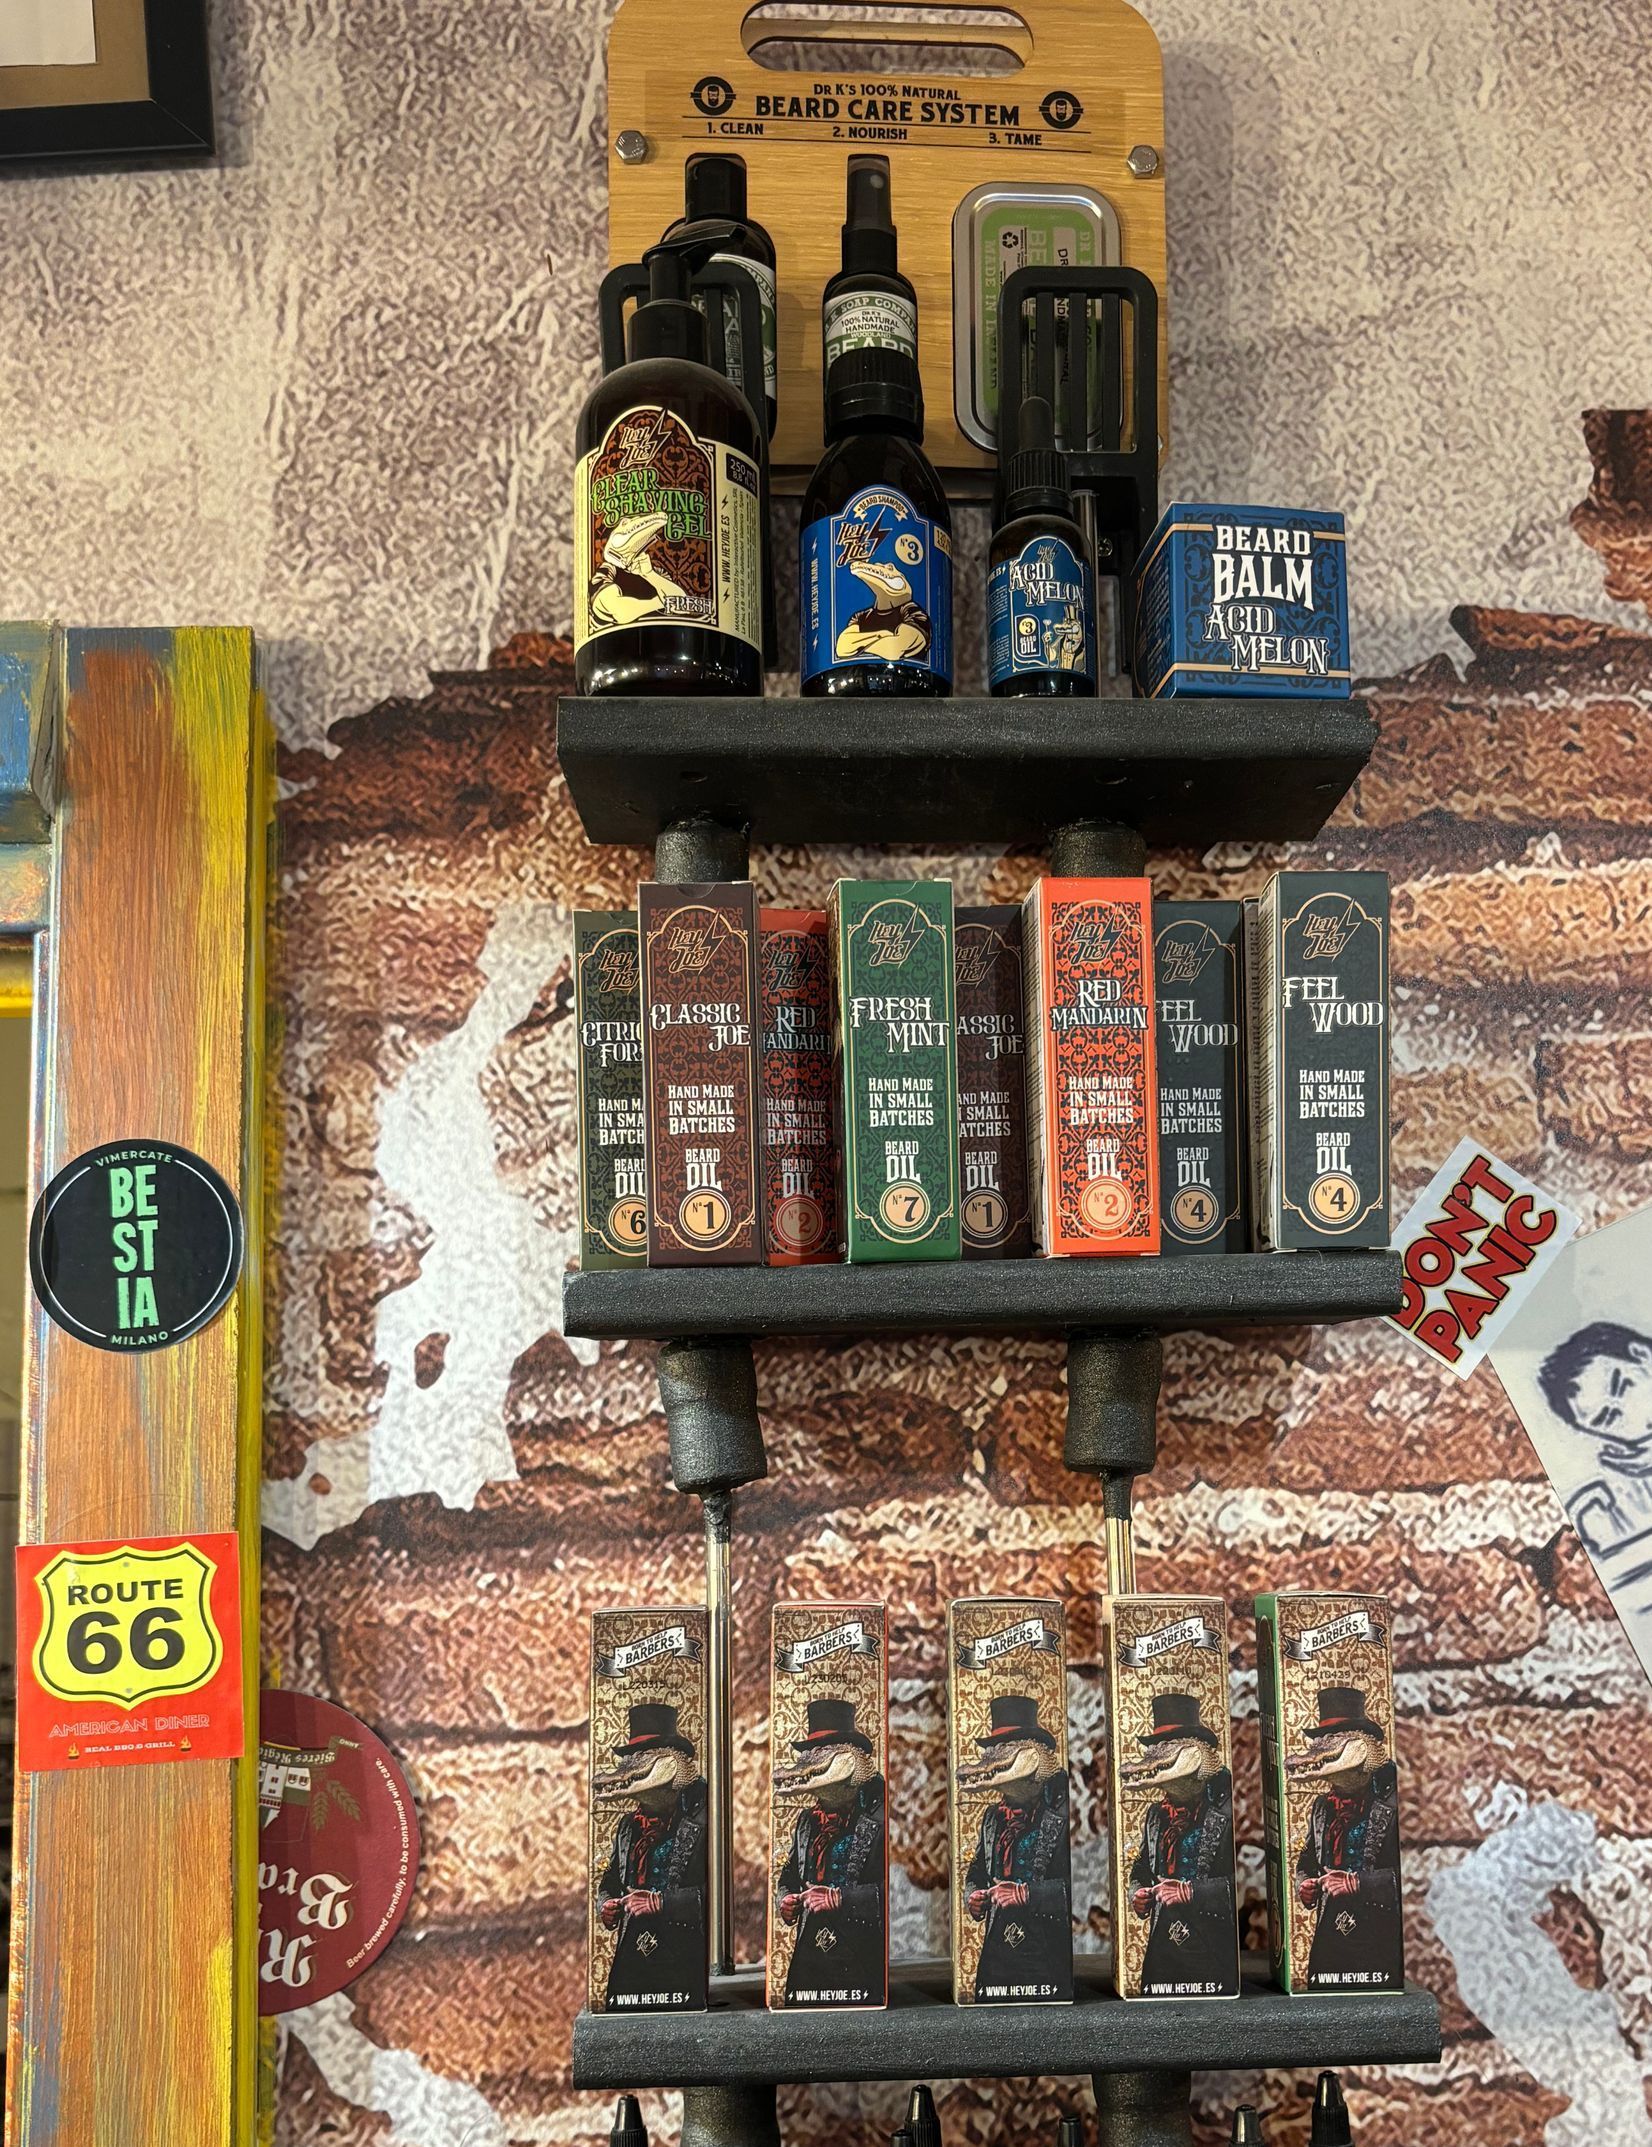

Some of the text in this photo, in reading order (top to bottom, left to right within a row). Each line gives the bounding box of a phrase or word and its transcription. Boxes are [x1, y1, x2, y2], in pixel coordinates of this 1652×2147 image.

[860, 84, 898, 98] 100%
[902, 85, 961, 101] NATURAL
[755, 96, 1020, 126] BEARD CARE SYSTEM
[707, 122, 764, 135] 1. CLEAN
[832, 126, 908, 140] 2. NOURISH
[988, 132, 1042, 146] 3. TAME
[840, 297, 870, 312] SOAP
[985, 293, 997, 314] IN
[841, 316, 900, 328] 100% NATURAL
[845, 324, 896, 334] HANDMADE
[730, 458, 746, 475] 250
[592, 468, 659, 514] CLEAR
[605, 489, 706, 530] SHAVING
[858, 496, 905, 512] BEARD SHAMPOO
[665, 512, 712, 542] GEL
[720, 514, 732, 584] WWW.HEYJOE.ES
[1216, 524, 1311, 556] BEARD
[907, 541, 920, 561] 3
[1010, 562, 1054, 592] ACID
[1212, 552, 1315, 613] BALM
[1026, 580, 1084, 610] MELON
[664, 595, 714, 616] FRESH
[1204, 603, 1276, 641] ACID
[1020, 636, 1036, 646] BEARD
[1020, 642, 1037, 655] OIL
[1231, 634, 1330, 676] MELON
[1076, 978, 1122, 1007] RED
[1282, 976, 1345, 1008] FEEL
[650, 1002, 740, 1031] CLASSIC
[776, 1006, 816, 1034] RED
[850, 996, 932, 1030] FRESH
[1051, 1006, 1148, 1031] MANDARIN
[1309, 1002, 1384, 1034] WOOD
[708, 1024, 750, 1052] JOE
[888, 1022, 950, 1054] MINT
[986, 1034, 1024, 1060] JOE
[1169, 1023, 1239, 1053] WOOD
[868, 1077, 933, 1092] HAND MADE
[1068, 1075, 1133, 1090] HAND MADE
[1299, 1068, 1366, 1084] HAND MADE
[668, 1084, 735, 1099] HAND MADE
[869, 1092, 933, 1109] IN SMALL
[980, 1091, 1010, 1105] MADE
[1070, 1091, 1132, 1108] IN SMALL
[1160, 1087, 1222, 1102] HAND MADE
[1300, 1084, 1365, 1101] IN SMALL
[598, 1098, 628, 1113] HAND
[668, 1100, 734, 1116] IN SMALL
[766, 1098, 826, 1112] HAND MADE
[966, 1104, 1010, 1121] SMALL
[1160, 1102, 1222, 1117] IN SMALL
[1299, 1101, 1366, 1120] BATCHES
[599, 1113, 614, 1128] IN
[669, 1116, 736, 1136] BATCHES
[767, 1112, 826, 1128] IN SMALL
[869, 1110, 934, 1128] BATCHES
[1069, 1108, 1134, 1126] BATCHES
[1160, 1118, 1222, 1134] BATCHES
[767, 1128, 826, 1146] BATCHES
[1086, 1138, 1120, 1154] BEARD
[1316, 1132, 1352, 1148] BEARD
[685, 1148, 720, 1163] BEARD
[884, 1140, 919, 1156] BEARD
[1176, 1147, 1210, 1162] BEARD
[94, 1150, 174, 1168] VIMERCATE
[781, 1158, 813, 1174] BEARD
[964, 1151, 998, 1166] BEARD
[1086, 1152, 1122, 1182] OIL
[1316, 1146, 1353, 1176] OIL
[686, 1162, 723, 1192] OIL
[885, 1154, 921, 1184] OIL
[966, 1164, 1000, 1192] OIL
[1177, 1160, 1212, 1188] OIL
[615, 1171, 646, 1199] OIL
[782, 1172, 815, 1200] OIL
[903, 1195, 920, 1222] 7
[1104, 1193, 1119, 1218] 2
[1330, 1186, 1348, 1213] 4
[703, 1201, 716, 1230] 1
[982, 1201, 994, 1228] 1
[1190, 1198, 1206, 1222] 4
[630, 1210, 646, 1235] 6
[797, 1212, 812, 1235] 2
[1414, 1194, 1558, 1364] PANIC
[110, 1330, 170, 1346] MILANO
[67, 1578, 184, 1606] ROUTE
[66, 1606, 186, 1675] 66
[986, 1628, 1033, 1656] BARBERS
[1146, 1626, 1194, 1654] BARBERS
[1312, 1620, 1359, 1648] BARBERS
[625, 1635, 675, 1665] BARBERS
[804, 1631, 852, 1660] BARBERS
[49, 1714, 210, 1739] AMERICAN DINER
[84, 1746, 113, 1754] REAL
[144, 1741, 176, 1749] GRILL
[338, 1738, 360, 1750] ANNO
[374, 1756, 392, 1781] care.
[386, 1776, 401, 1800] with
[394, 1800, 410, 1848] consumed
[400, 1850, 409, 1863] be
[399, 1864, 408, 1876] to
[364, 1916, 390, 1952] brewed
[346, 1949, 366, 1969] Beer
[1150, 1982, 1216, 1995] WWW.HEYJOE.ES
[1318, 1972, 1382, 1985] WWW.HEYJOE.ES
[616, 1994, 684, 2006] WWW.HEYJOE.ES
[796, 1990, 862, 2001] WWW.HEYJOE.ES
[986, 1984, 1051, 1997] WWW.HEYJOE.ES
